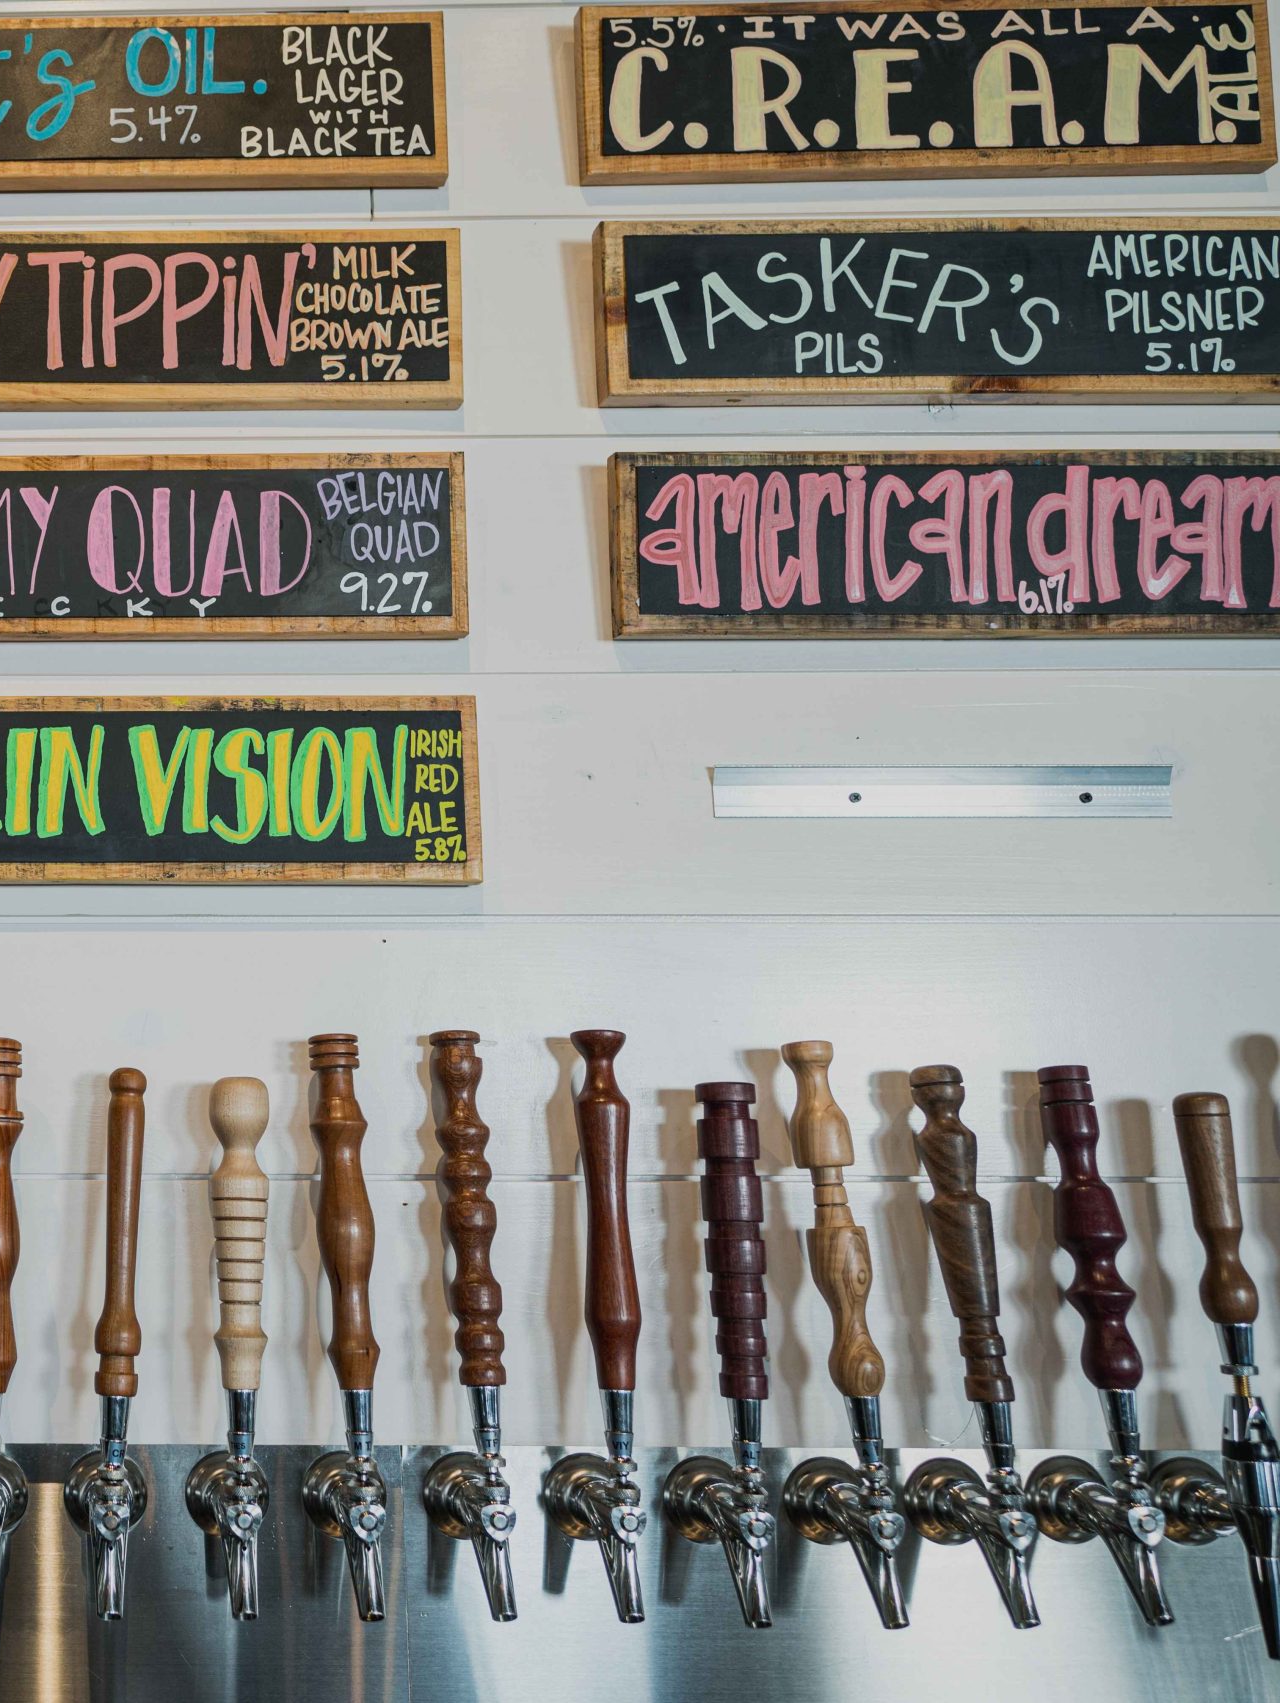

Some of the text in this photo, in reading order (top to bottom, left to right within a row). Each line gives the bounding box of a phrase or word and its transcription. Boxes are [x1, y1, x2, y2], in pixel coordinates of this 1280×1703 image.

[282, 26, 392, 67] BLACK
[610, 7, 1175, 47] 5.5% IT WAS ALL A
[125, 27, 268, 97] OIL.
[295, 68, 404, 106] LAGER
[110, 105, 202, 144] 5.4%
[309, 109, 389, 124] WITH
[240, 124, 431, 157] BLACK TEA
[333, 243, 416, 279] MILK
[1087, 233, 1280, 281] AMERICAN
[295, 282, 442, 315] CHOCOLATE
[634, 237, 1060, 365] TASKER'S
[1105, 286, 1265, 334] PILSNER
[291, 317, 449, 351] BROWN ALE
[795, 331, 884, 374] PILS
[321, 354, 409, 381] 5.1%
[1145, 337, 1236, 372] 5.1%
[317, 471, 444, 520] BELGIAN
[86, 485, 312, 598] QUAD
[350, 519, 440, 563] QUAD
[639, 465, 1280, 611] american dream
[339, 571, 433, 613] 9.2%
[1018, 572, 1074, 614] 6.1%
[410, 729, 462, 759] IRISH
[128, 724, 408, 844] VISION
[415, 764, 459, 795] RED
[406, 801, 458, 838] ALE
[415, 834, 466, 862] 5.8%
